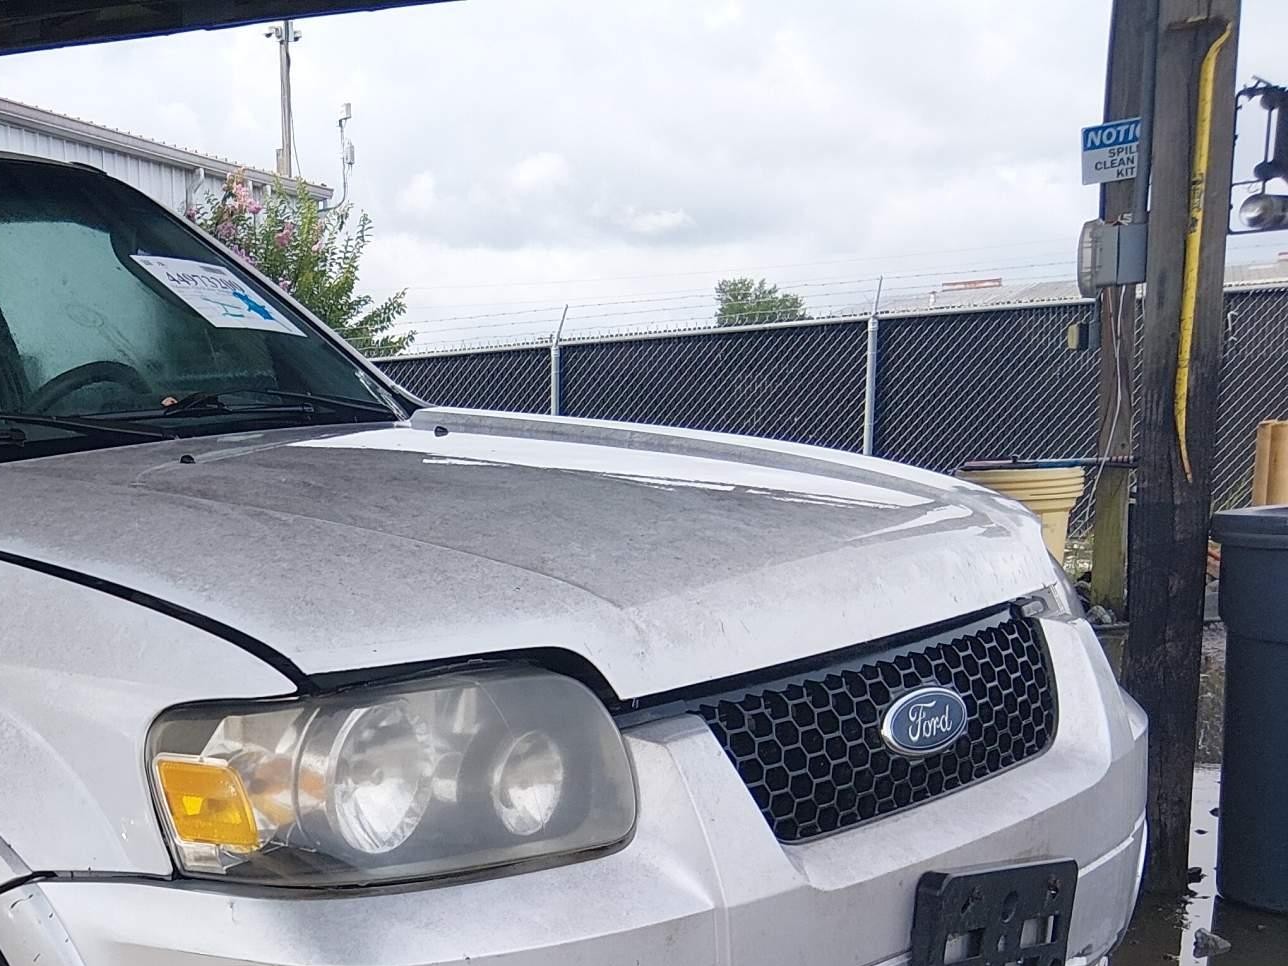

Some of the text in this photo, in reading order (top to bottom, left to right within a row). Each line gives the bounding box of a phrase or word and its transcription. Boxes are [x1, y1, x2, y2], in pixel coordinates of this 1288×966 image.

[1108, 145, 1138, 158] SPIL
[1094, 155, 1135, 172] CLEAN
[1116, 166, 1135, 179] KIT
[908, 700, 953, 742] Ford
